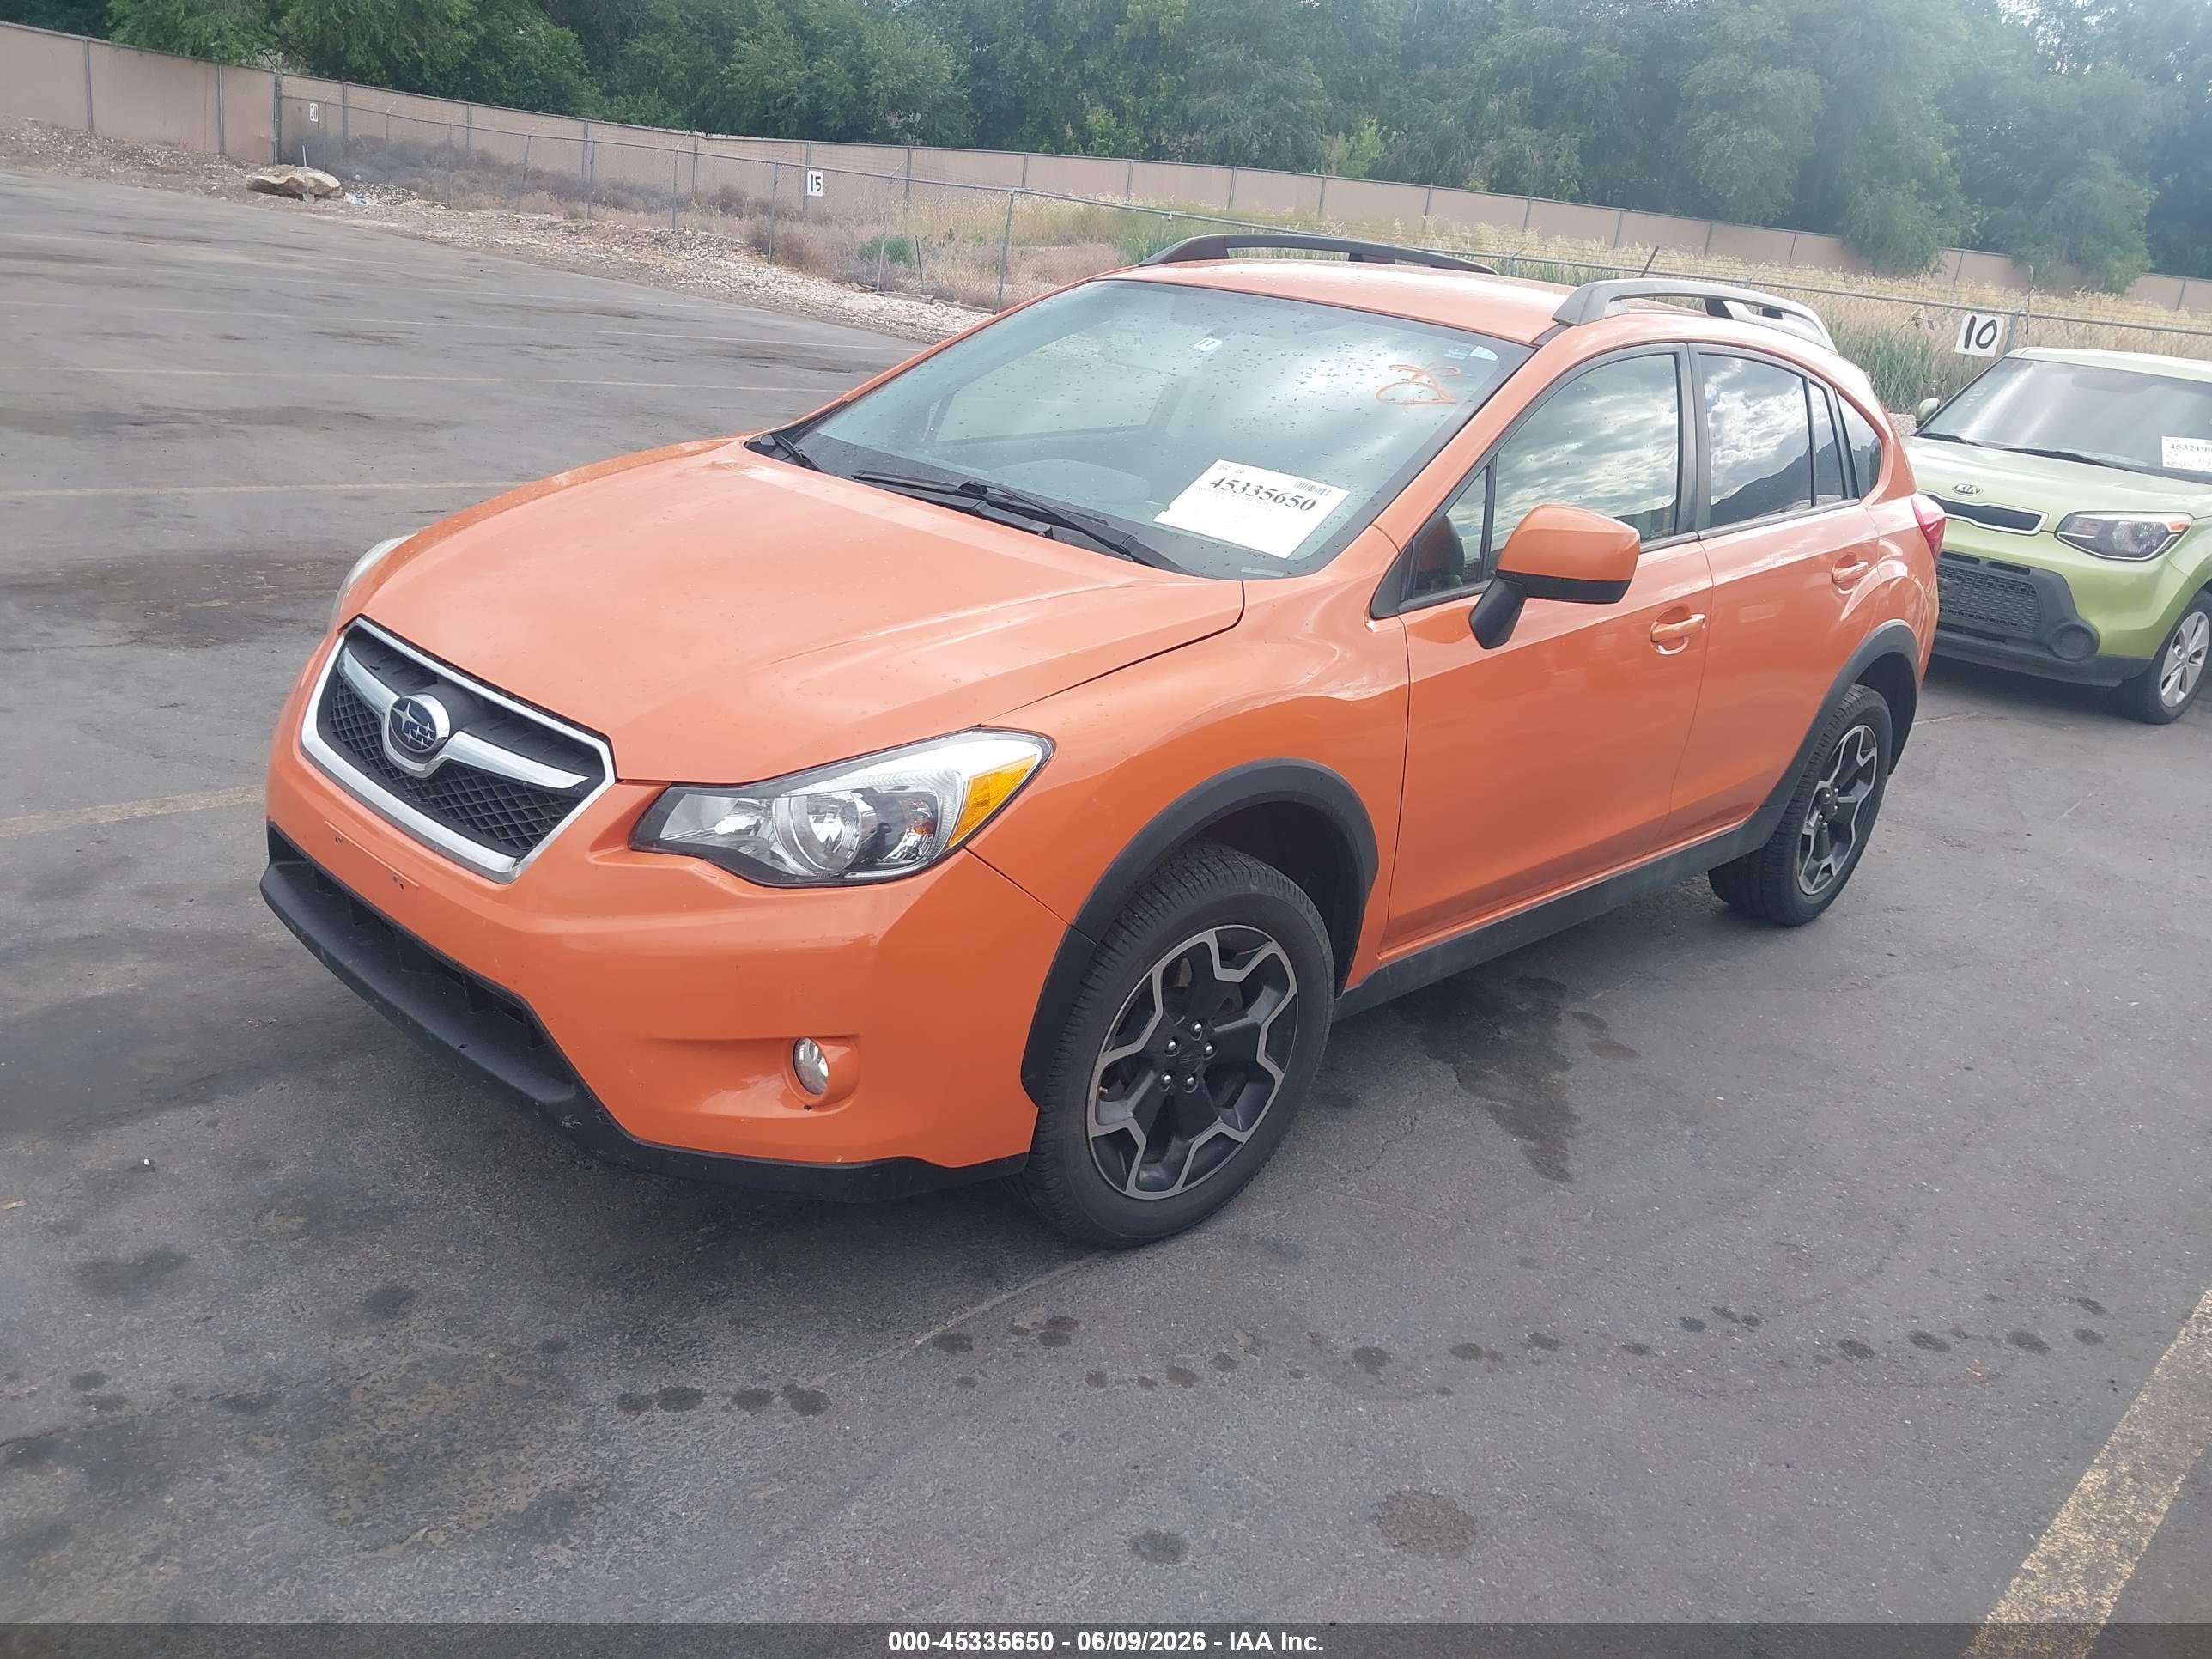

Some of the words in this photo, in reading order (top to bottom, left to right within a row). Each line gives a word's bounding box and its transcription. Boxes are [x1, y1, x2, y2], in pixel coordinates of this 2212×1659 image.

[311, 105, 318, 120] 20
[811, 173, 822, 192] 15
[1964, 315, 1998, 349] 10
[1209, 477, 1317, 512] 45335650
[1956, 483, 1977, 494] KIA
